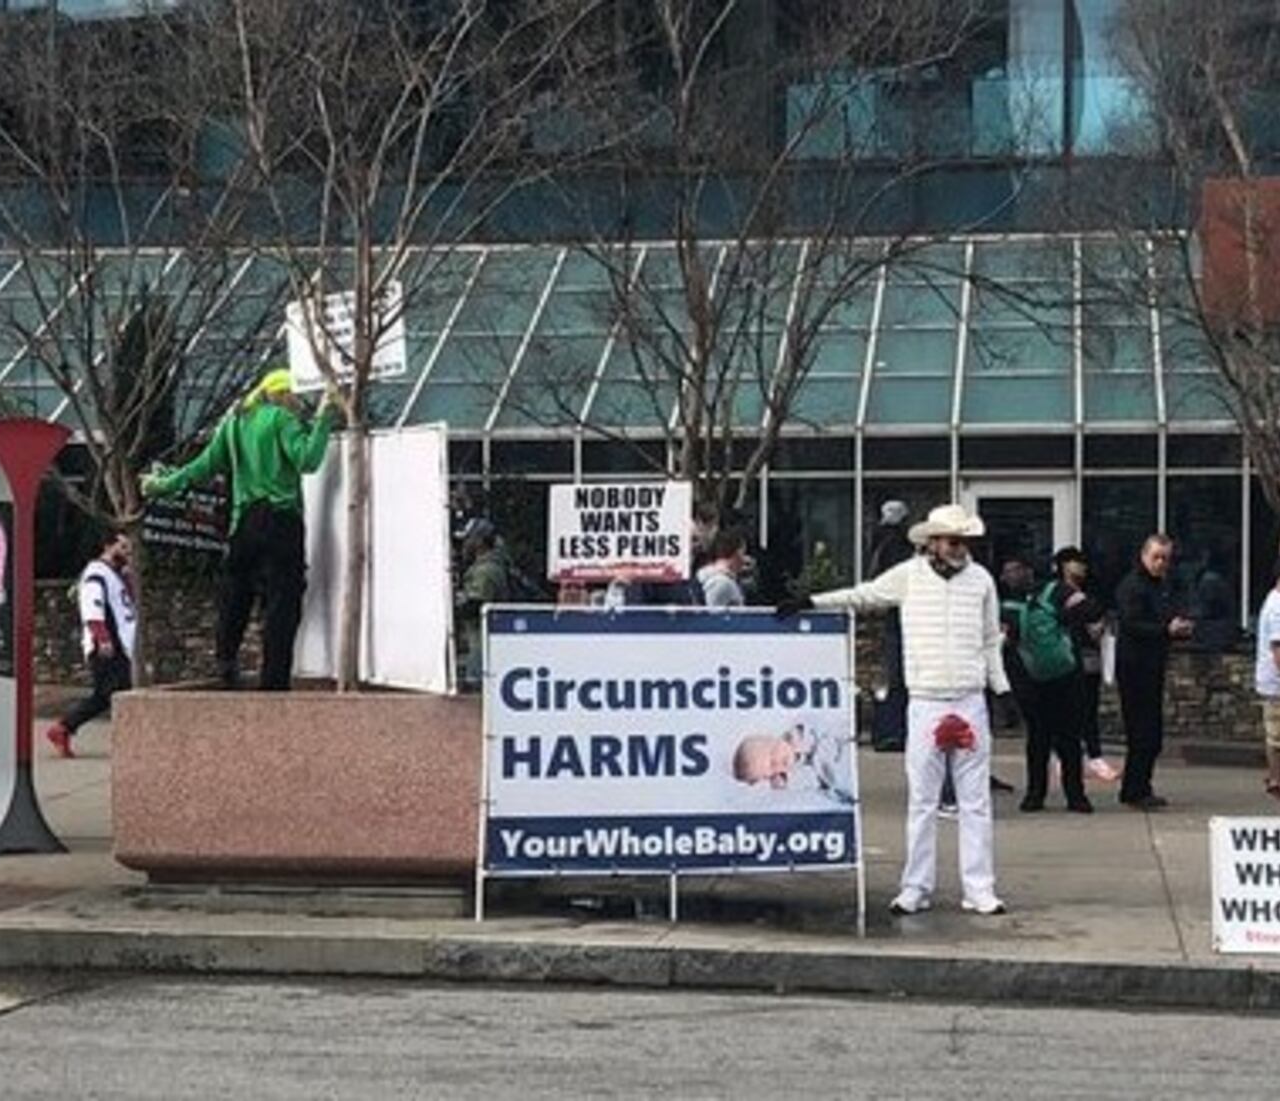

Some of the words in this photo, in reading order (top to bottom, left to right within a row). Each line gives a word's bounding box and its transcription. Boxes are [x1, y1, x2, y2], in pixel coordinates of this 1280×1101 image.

[574, 487, 666, 509] NOBODY
[580, 511, 660, 533] WANTS
[558, 536, 610, 559] LESS
[617, 535, 681, 558] PENIS
[500, 666, 841, 712] Circumcision
[502, 734, 711, 780] HARMS
[500, 824, 846, 861] YourWholeBaby.org
